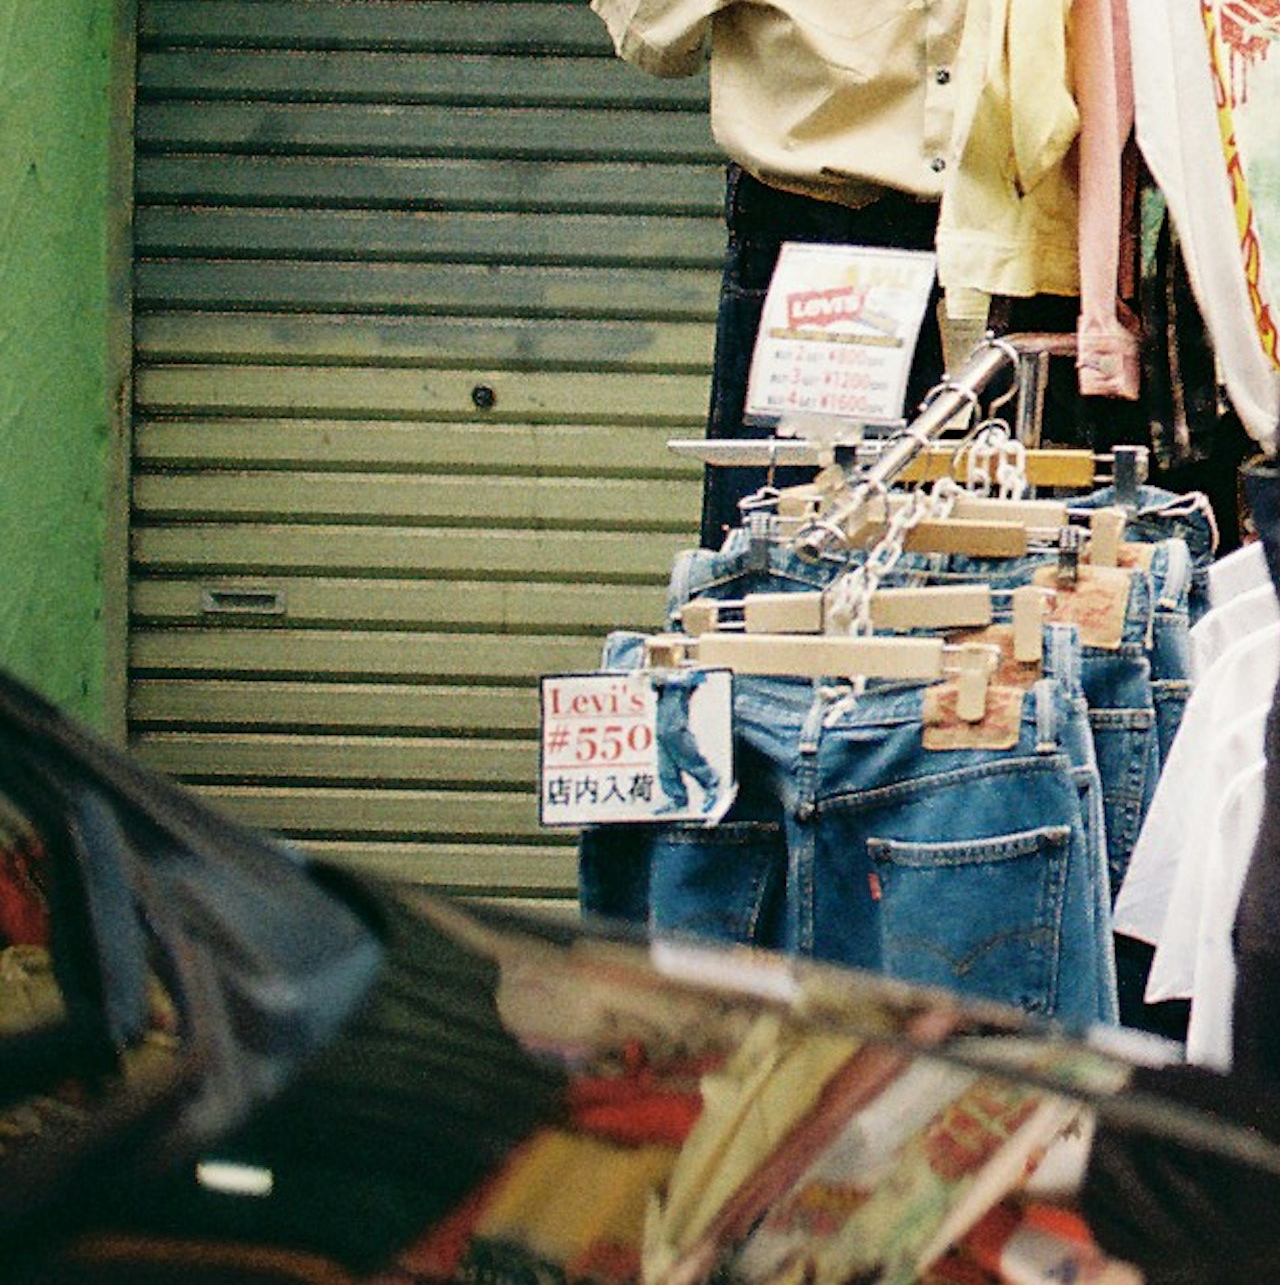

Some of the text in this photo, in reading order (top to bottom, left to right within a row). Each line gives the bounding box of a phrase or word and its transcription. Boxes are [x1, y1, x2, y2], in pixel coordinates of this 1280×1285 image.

[551, 684, 645, 715] Levi's
[548, 723, 653, 762] #550
[548, 774, 654, 806] 店内入荷
